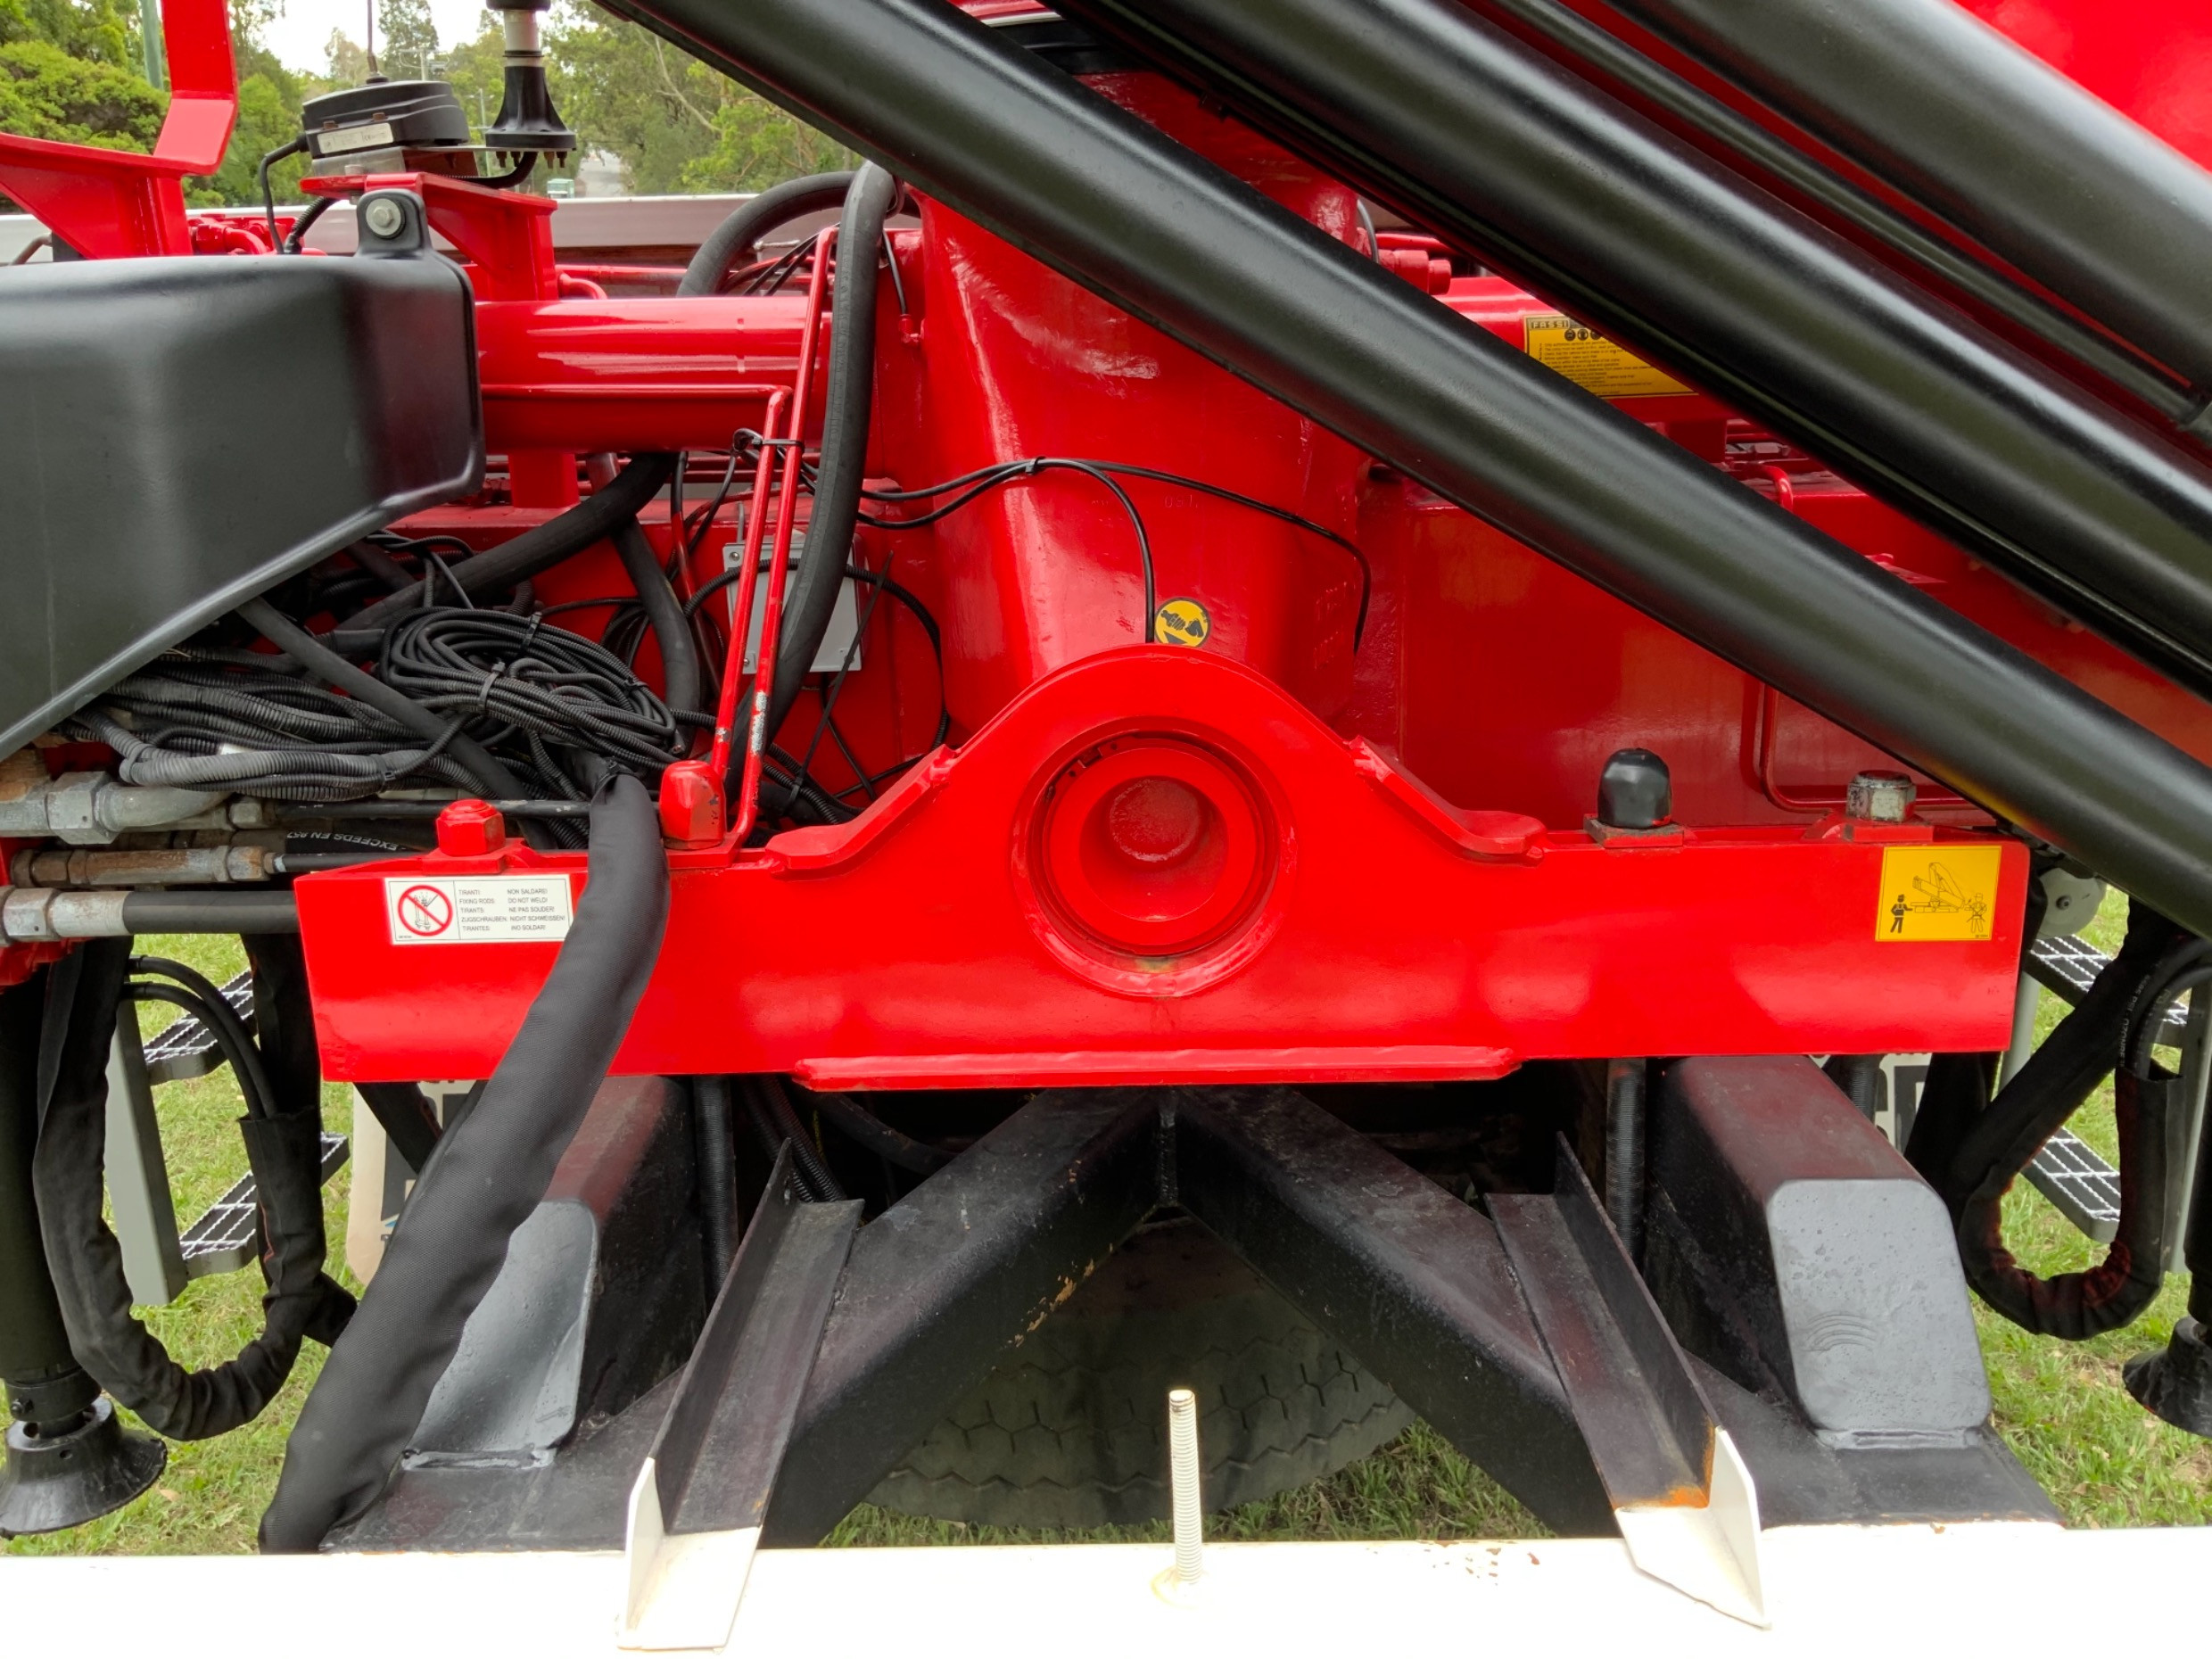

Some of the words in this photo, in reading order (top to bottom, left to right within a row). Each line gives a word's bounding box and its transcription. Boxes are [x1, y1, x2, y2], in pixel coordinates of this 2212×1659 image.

[1533, 321, 1568, 329] FASSI
[310, 831, 331, 839] EN
[334, 833, 399, 851] EXCEEDS
